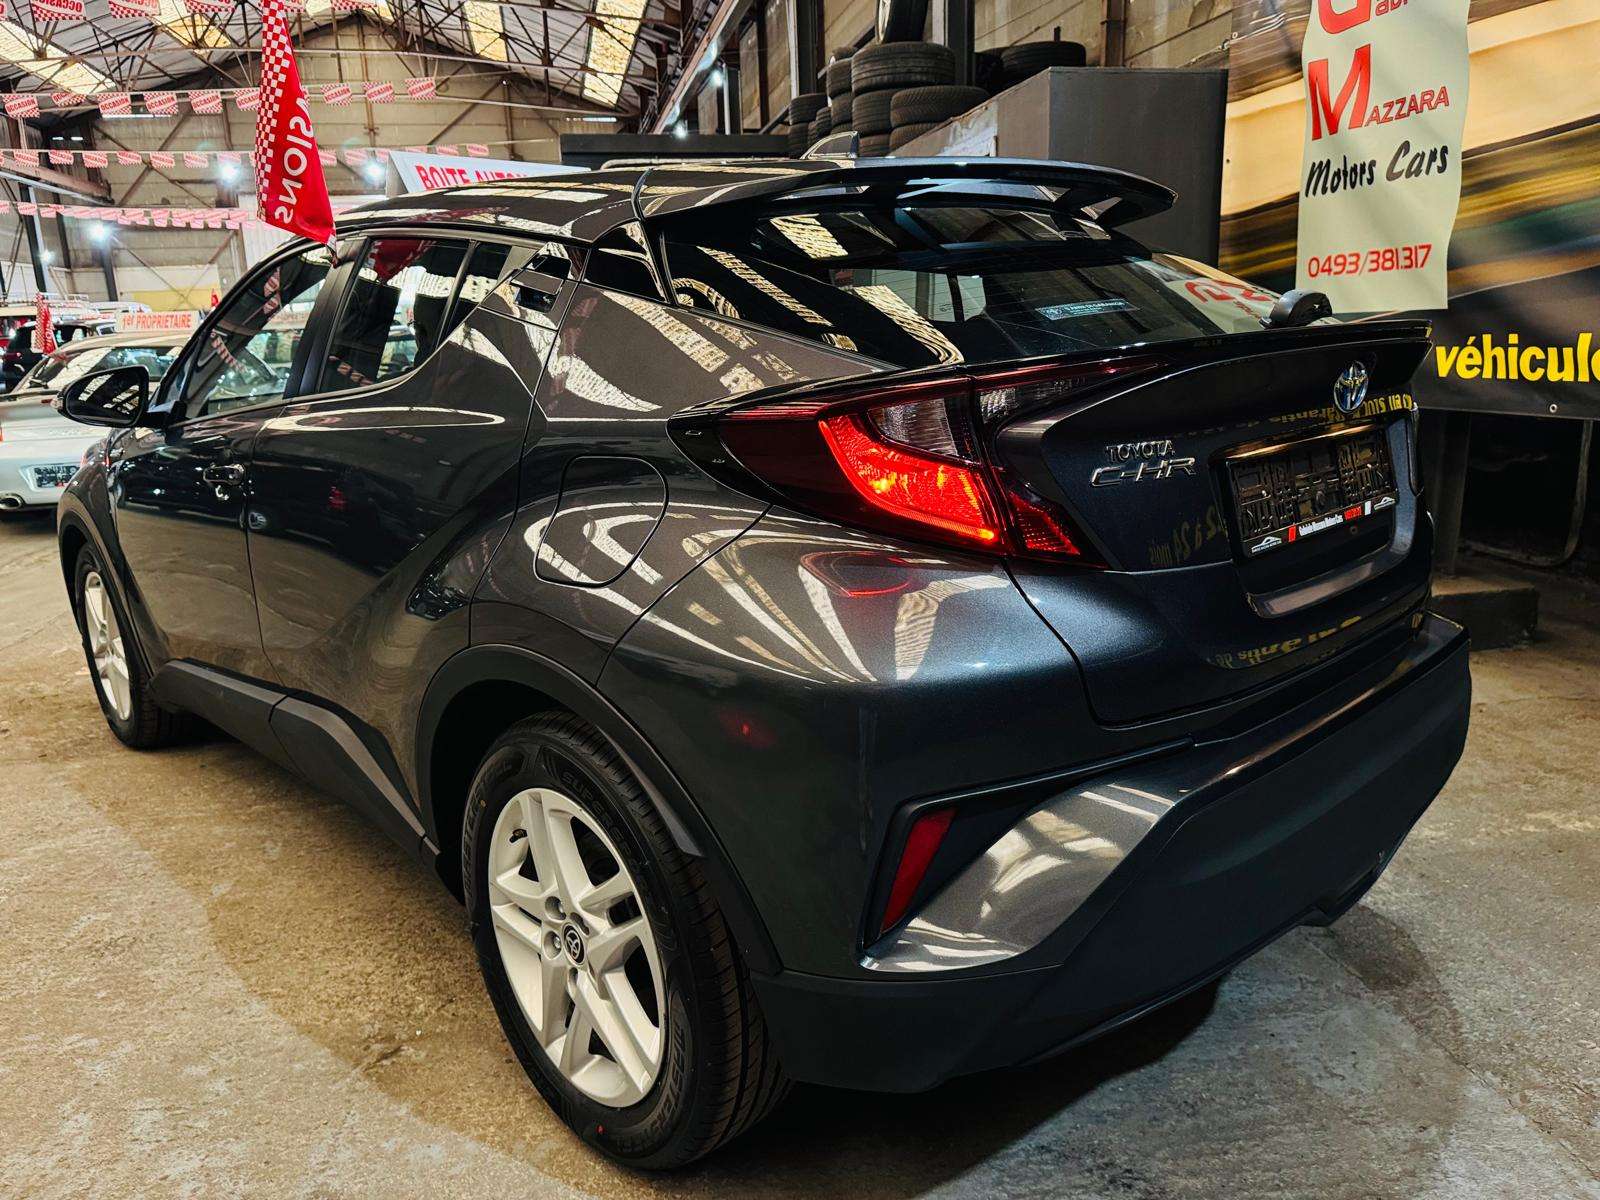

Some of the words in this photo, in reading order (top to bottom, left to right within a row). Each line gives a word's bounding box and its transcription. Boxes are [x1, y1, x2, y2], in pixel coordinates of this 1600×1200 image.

[100, 97, 129, 111] OCCASION
[1308, 43, 1449, 141] MAZZARA
[6, 98, 36, 113] OCCASION
[415, 164, 470, 190] BOITE
[1305, 155, 1376, 197] Motors
[1386, 140, 1449, 182] Cars
[136, 313, 192, 329] PROPRIETAIRE
[1106, 440, 1175, 462] TOYOTA
[1090, 457, 1196, 487] C-HR
